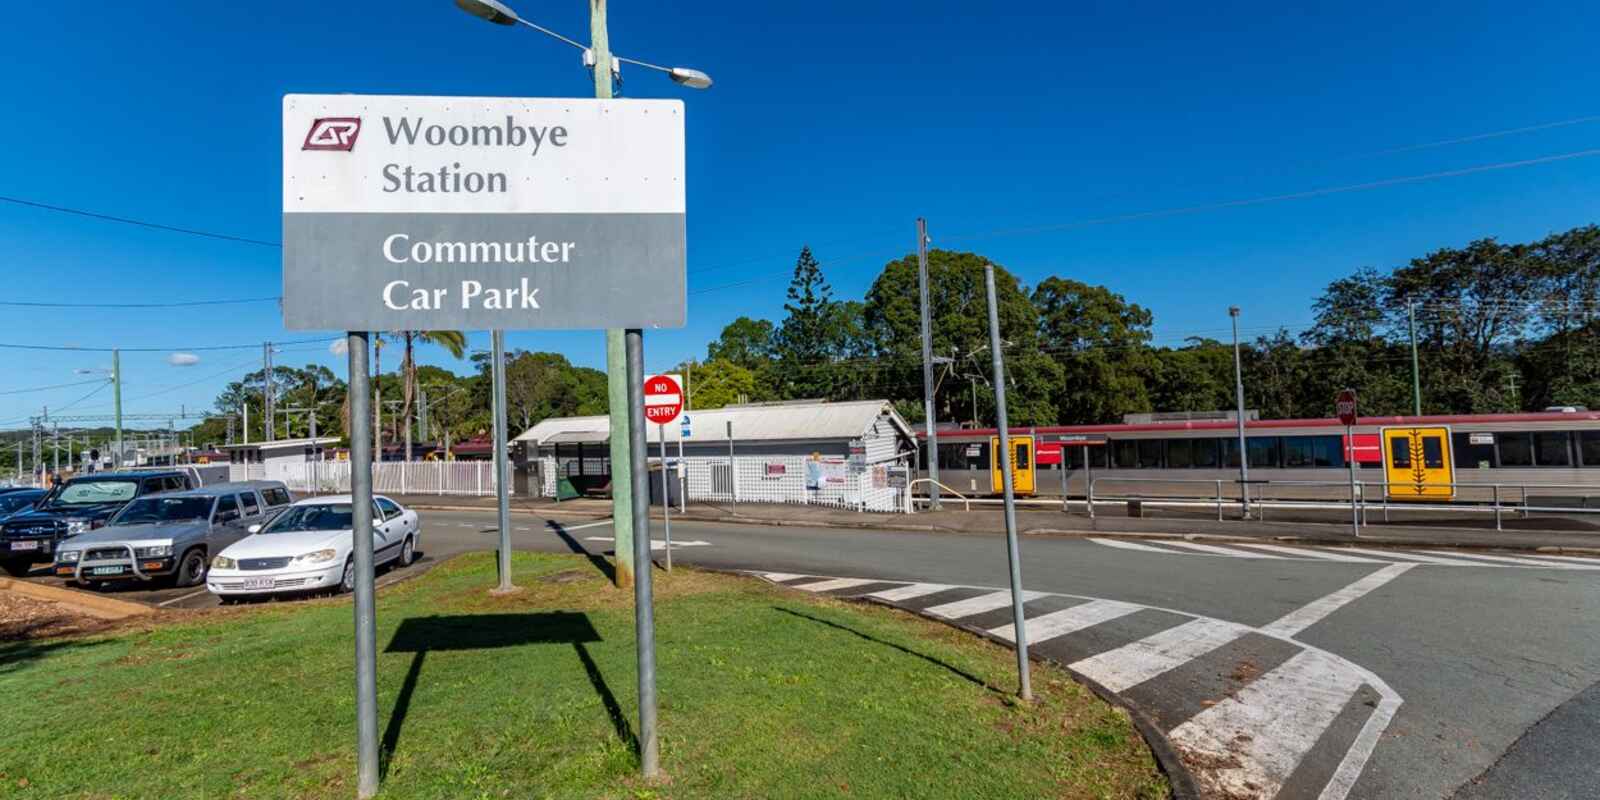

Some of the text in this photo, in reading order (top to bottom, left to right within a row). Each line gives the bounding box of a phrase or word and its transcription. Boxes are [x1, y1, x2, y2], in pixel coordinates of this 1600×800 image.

[382, 115, 568, 156] Woombye
[382, 162, 507, 193] Station
[382, 233, 576, 264] Commuter
[382, 277, 540, 310] Car Park
[654, 383, 668, 393] NO
[647, 407, 676, 417] ENTRY
[1336, 401, 1354, 415] STOP
